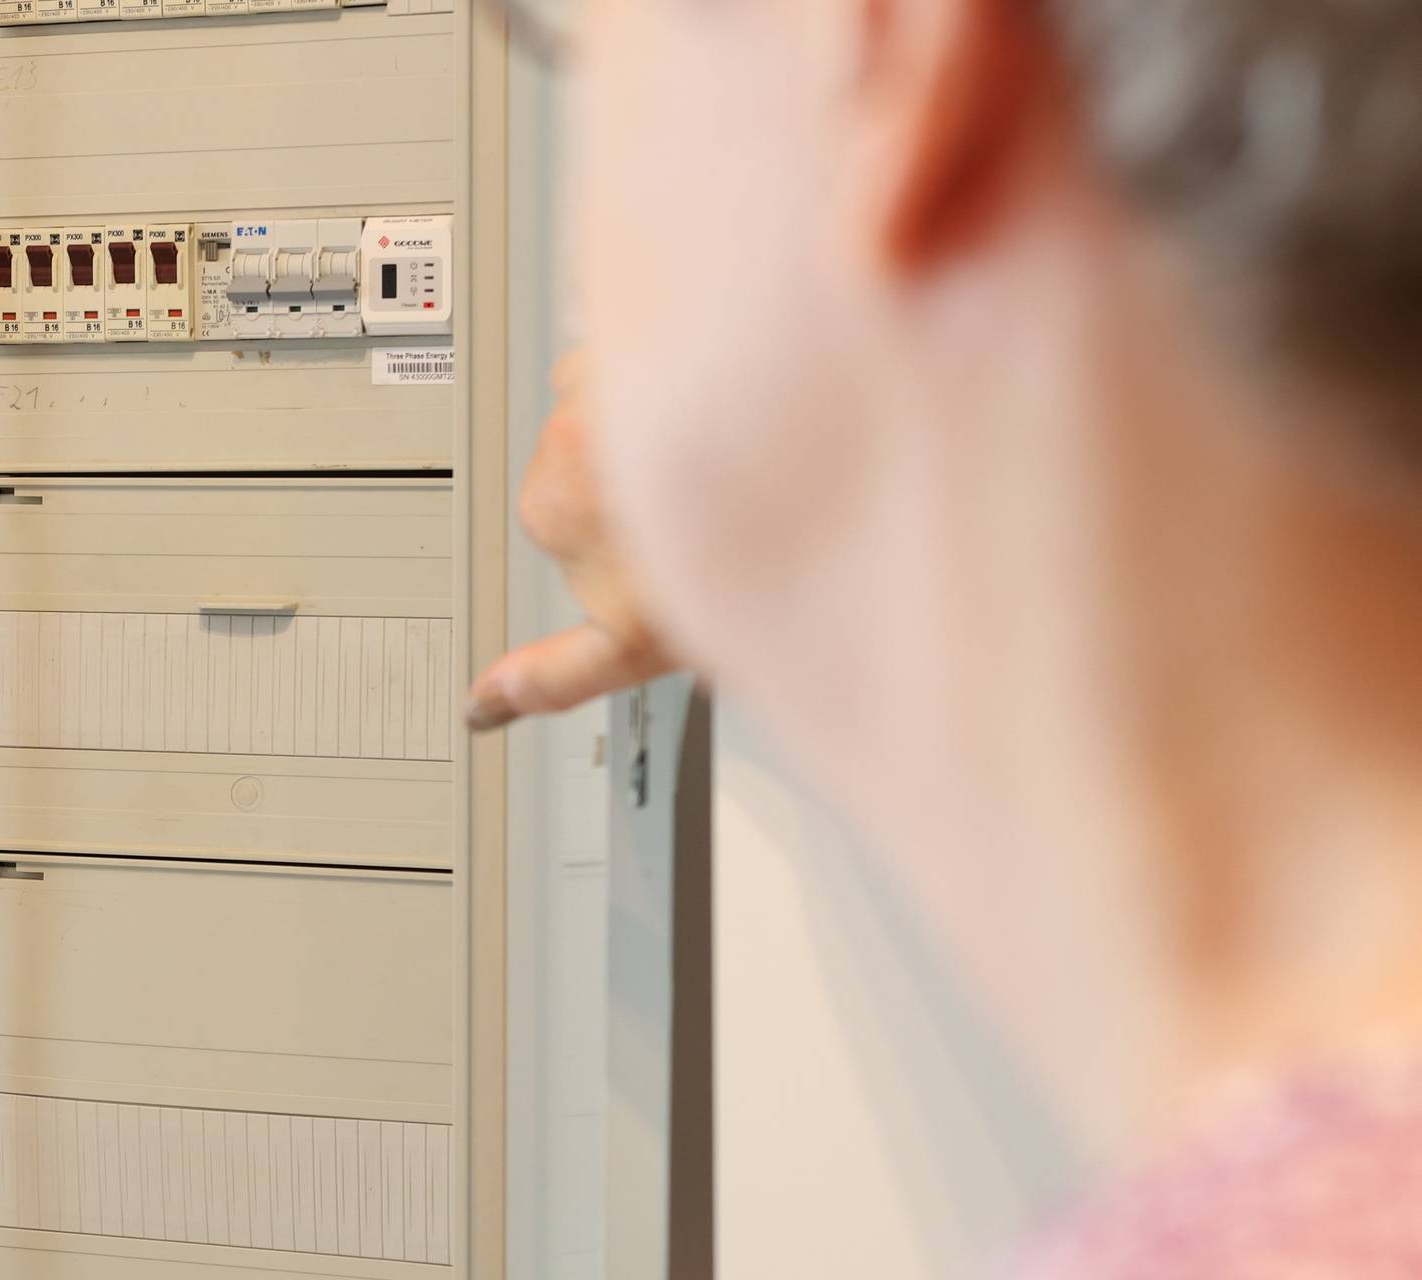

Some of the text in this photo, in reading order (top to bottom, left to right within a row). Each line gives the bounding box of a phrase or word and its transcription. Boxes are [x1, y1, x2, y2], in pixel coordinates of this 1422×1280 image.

[24, 3, 32, 11] 16
[65, 0, 73, 8] 16
[66, 233, 83, 241] PX300
[108, 230, 125, 238] PX300
[4, 323, 19, 332] B 16
[45, 323, 59, 332] B 16
[86, 323, 101, 332] B 16
[128, 319, 142, 328] B 16
[171, 321, 186, 329] B 16
[386, 352, 404, 360] Three
[405, 352, 425, 360] Phase
[425, 352, 448, 361] Energy
